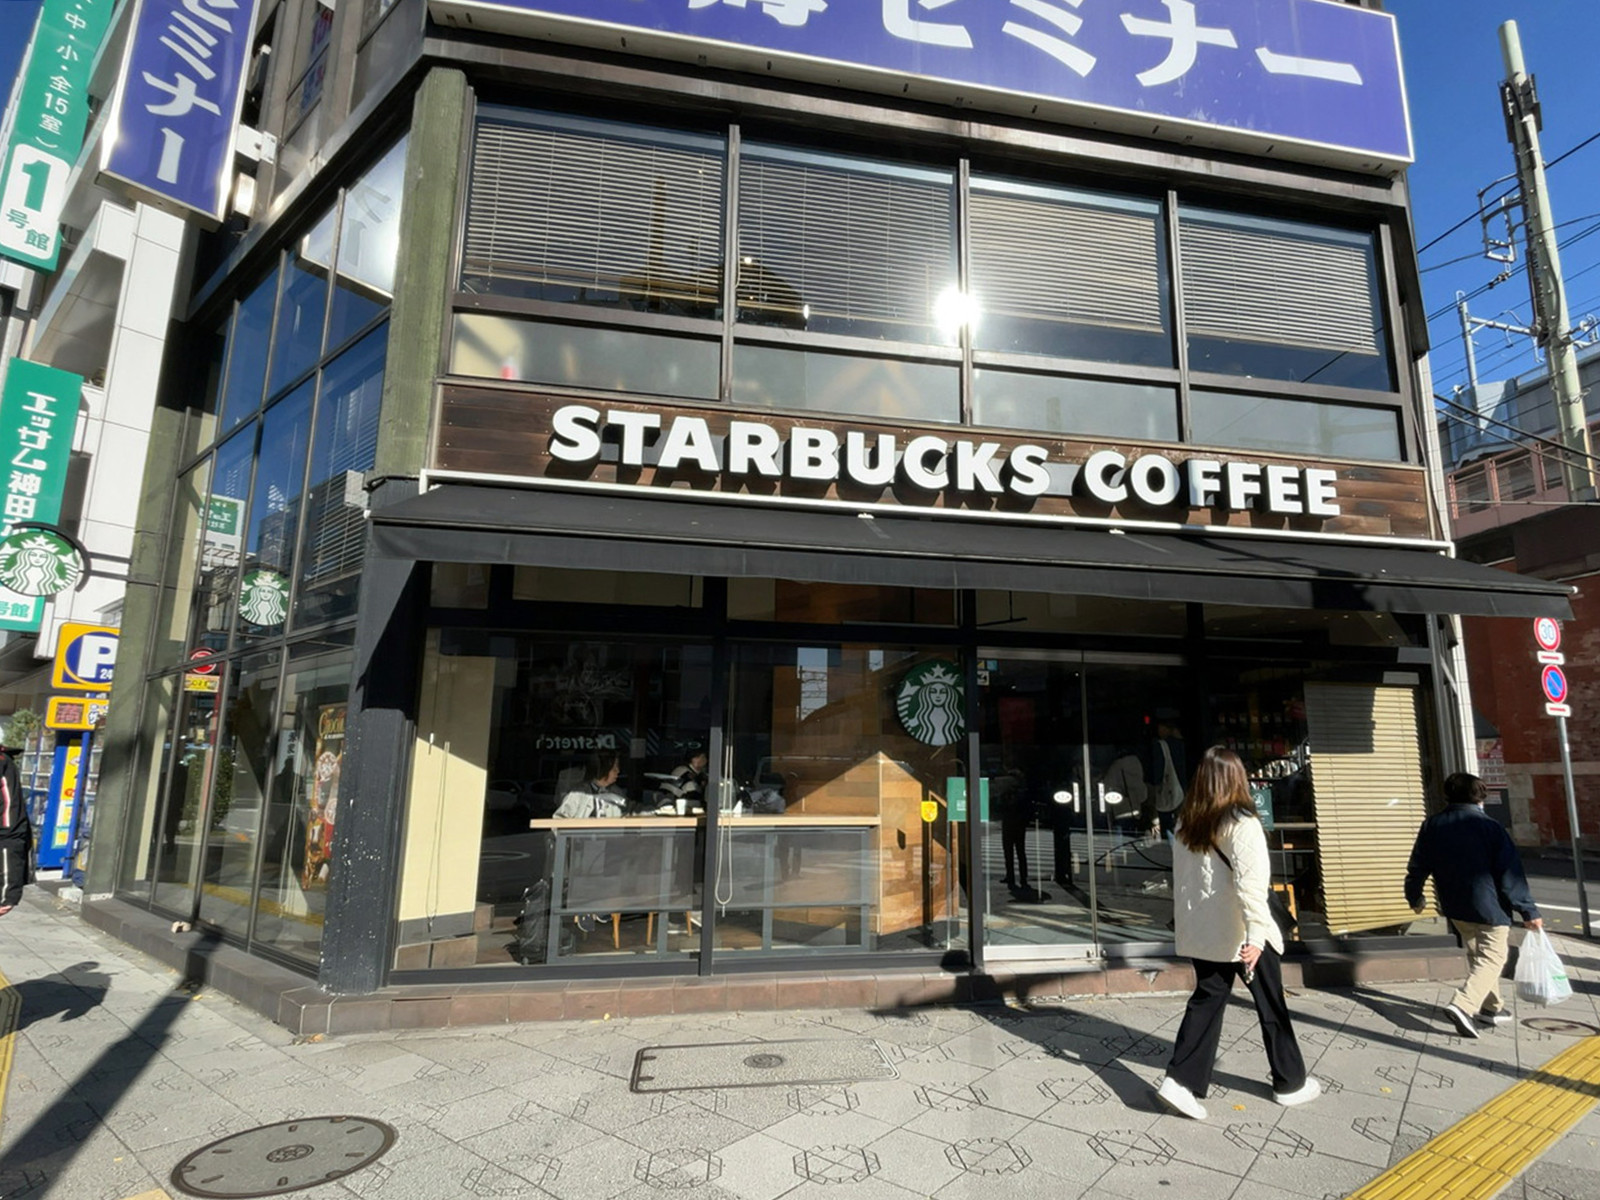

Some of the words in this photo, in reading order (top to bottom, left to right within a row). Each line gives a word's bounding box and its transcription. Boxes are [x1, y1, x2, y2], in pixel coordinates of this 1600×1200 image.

[550, 405, 1051, 496] STARBUCKS
[1084, 450, 1341, 516] COFFEE
[1540, 623, 1555, 641] 30
[77, 634, 119, 679] P
